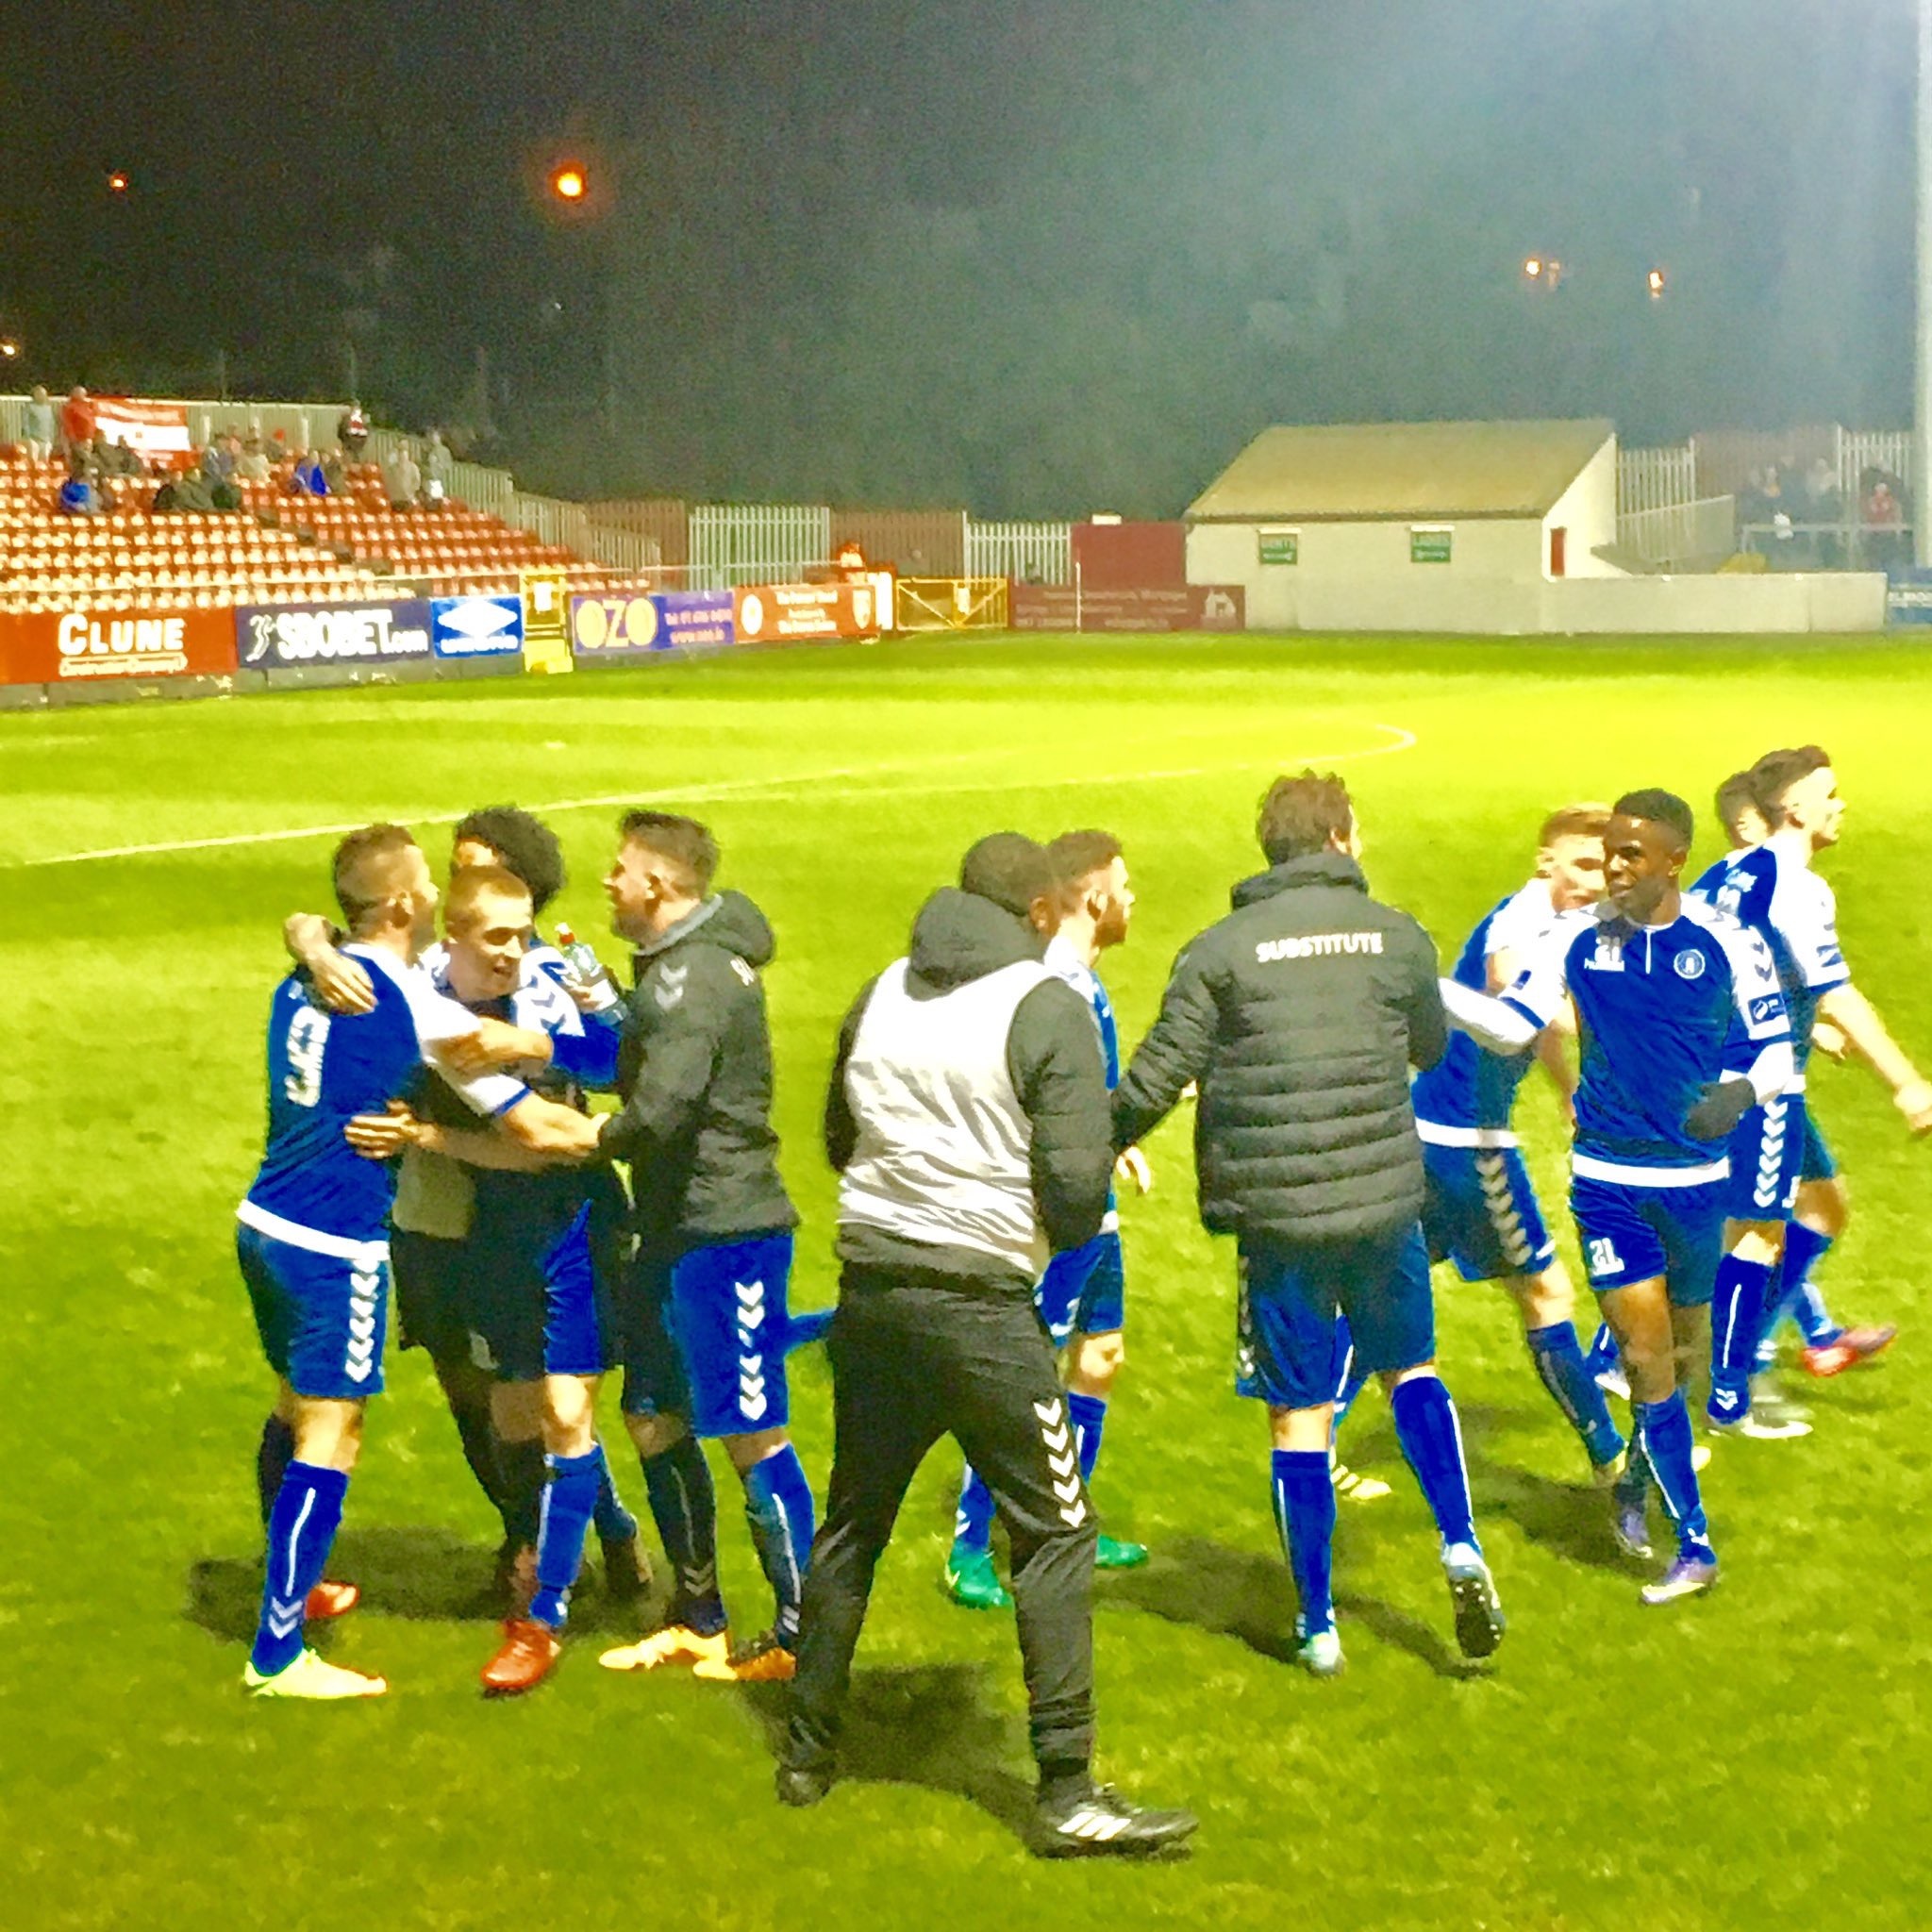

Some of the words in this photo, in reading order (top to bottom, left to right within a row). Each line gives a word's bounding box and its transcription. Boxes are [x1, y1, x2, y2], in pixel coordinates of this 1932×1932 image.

[576, 598, 657, 649] OZO
[1256, 932, 1383, 962] SUBSTITUTE
[1590, 1237, 1625, 1275] 21
